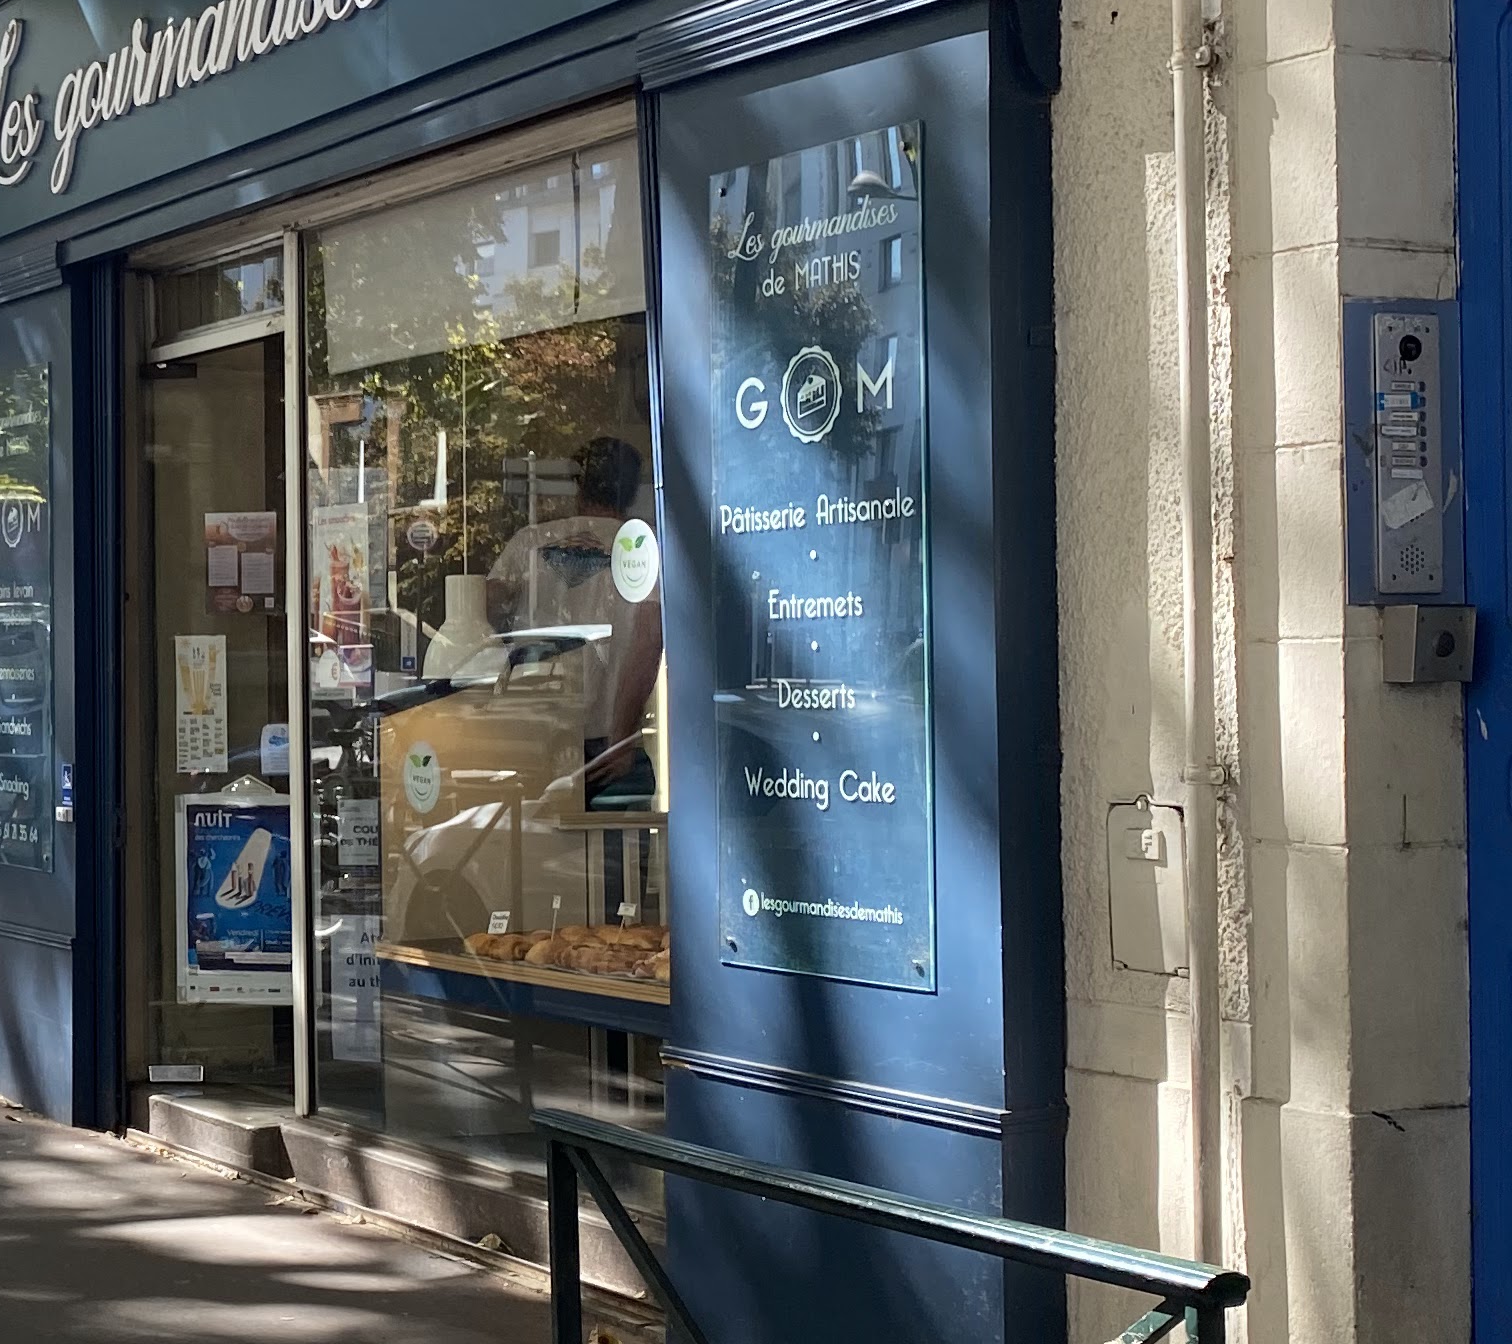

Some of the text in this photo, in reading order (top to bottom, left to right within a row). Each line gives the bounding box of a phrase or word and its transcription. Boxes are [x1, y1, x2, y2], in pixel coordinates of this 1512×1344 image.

[727, 193, 899, 265] Les gourmandises
[761, 250, 862, 298] de MATHIS
[720, 486, 915, 535] Pâtisserie Artisanale
[622, 560, 647, 569] VEGAN
[13, 580, 34, 598] levain
[767, 588, 864, 620] Entremets
[777, 678, 856, 710] Desserts
[412, 775, 432, 785] VEGAN
[744, 765, 896, 811] Wedding Cake
[759, 891, 904, 925] lesgourmandisesdemathis
[348, 977, 366, 988] au
